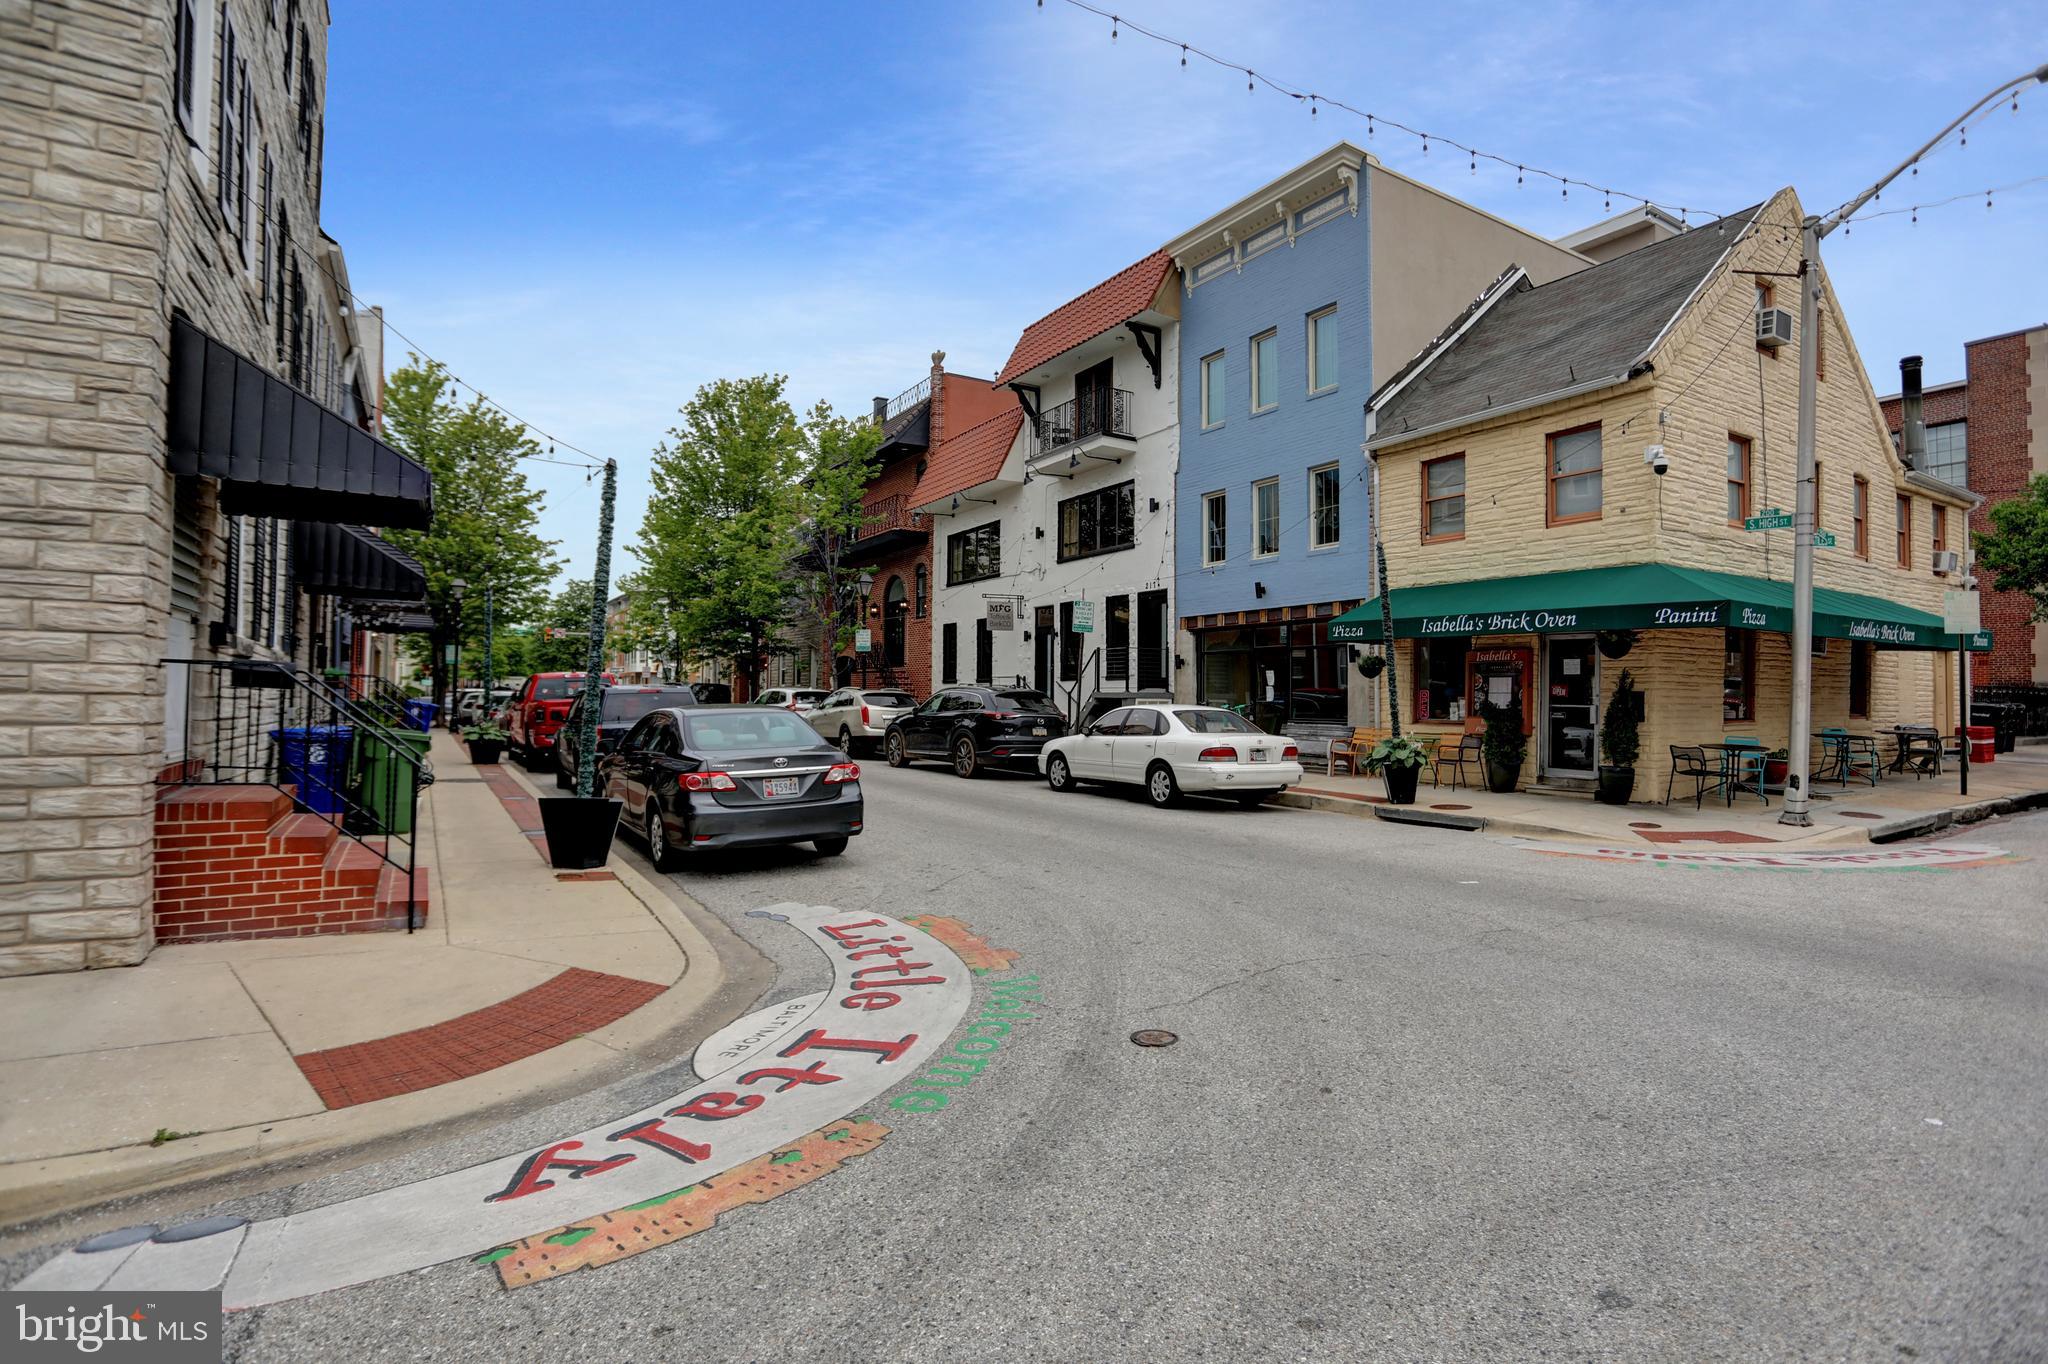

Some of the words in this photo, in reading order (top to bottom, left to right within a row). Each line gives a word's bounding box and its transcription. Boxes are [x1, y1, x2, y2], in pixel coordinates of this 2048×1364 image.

[1758, 517, 1778, 529] HIGH
[989, 604, 1011, 613] MFG
[1654, 606, 1719, 624] Panini
[1742, 607, 1766, 625] Pizza
[1332, 623, 1363, 637] Pizza
[1421, 615, 1484, 633] Isabella's
[1488, 612, 1534, 632] Brick
[1535, 611, 1577, 628] Oven
[1848, 620, 1881, 640] Isabella's
[1881, 623, 1899, 644] Brick
[1899, 626, 1916, 641] Oven
[1476, 649, 1517, 662] Isabella's
[818, 917, 947, 1012] Little
[718, 1003, 806, 1058] BALTIMORE
[484, 1028, 920, 1203] Italy
